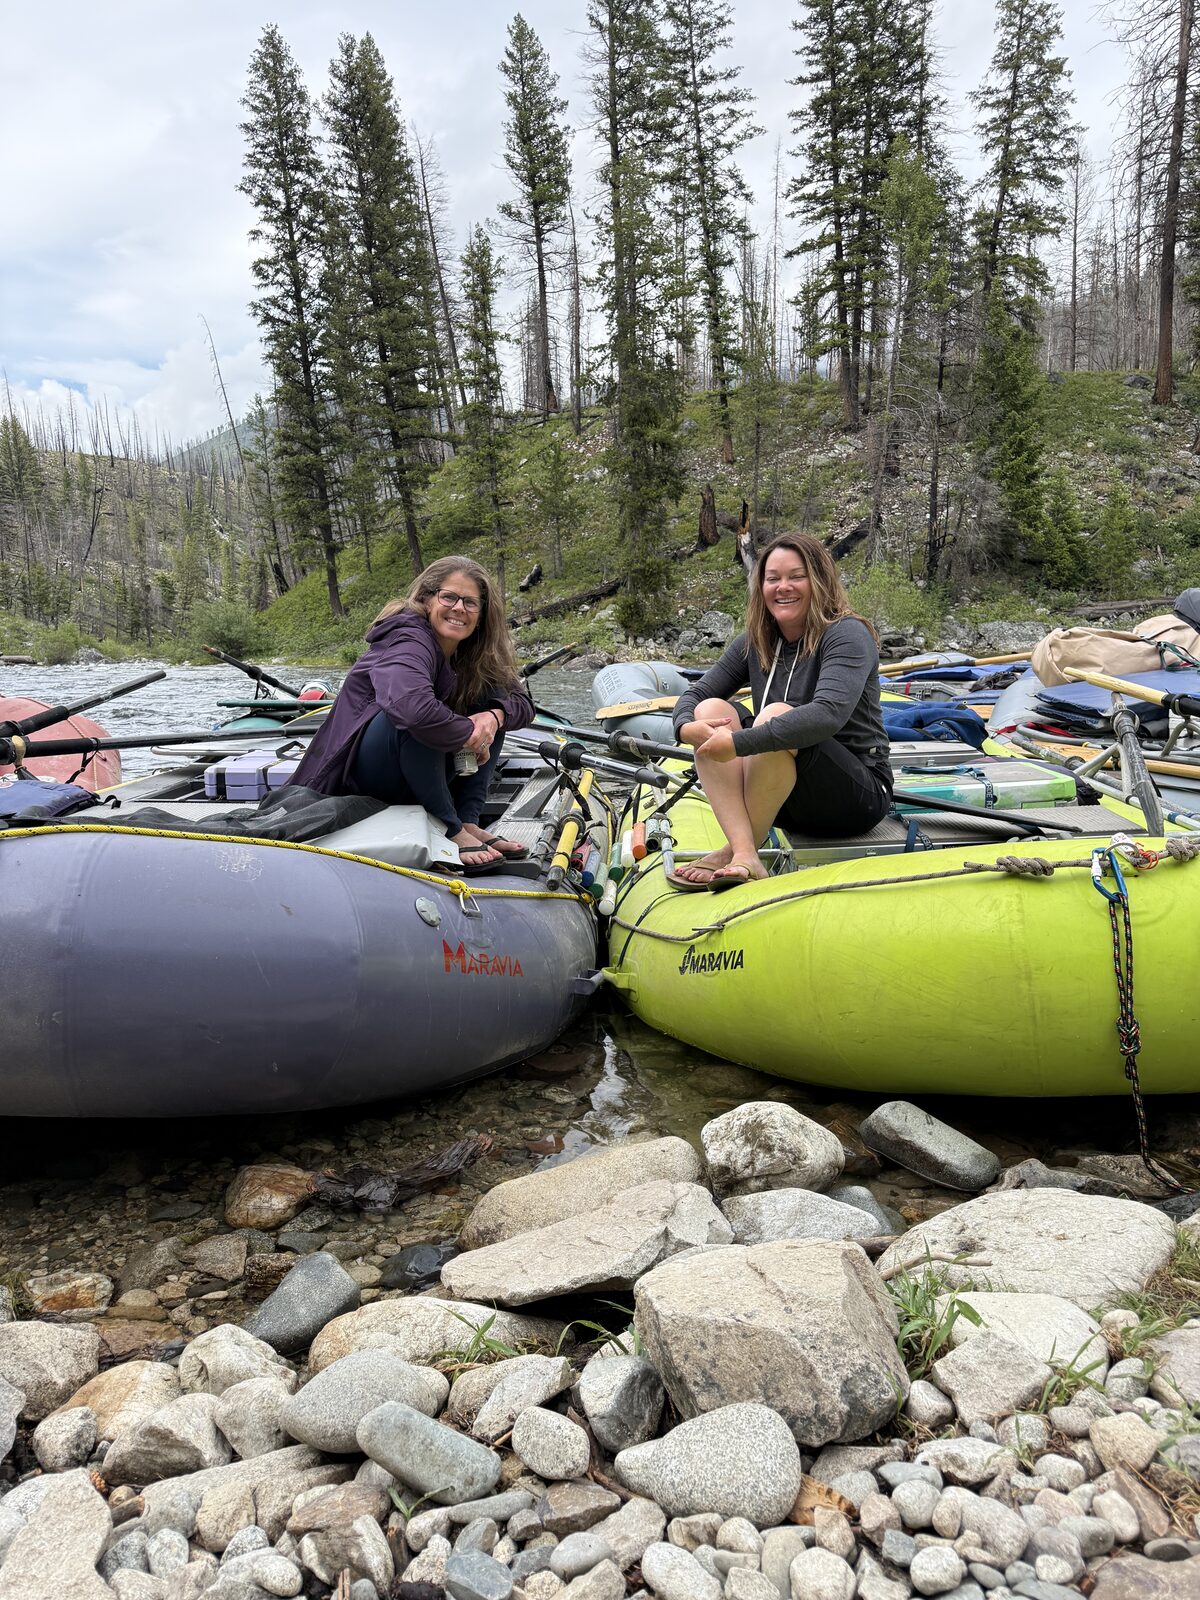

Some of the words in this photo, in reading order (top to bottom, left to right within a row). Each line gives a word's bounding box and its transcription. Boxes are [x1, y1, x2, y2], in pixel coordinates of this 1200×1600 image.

[602, 672, 616, 696] RIVER
[442, 938, 523, 977] MARAVIA
[689, 949, 744, 974] MARAVIA
